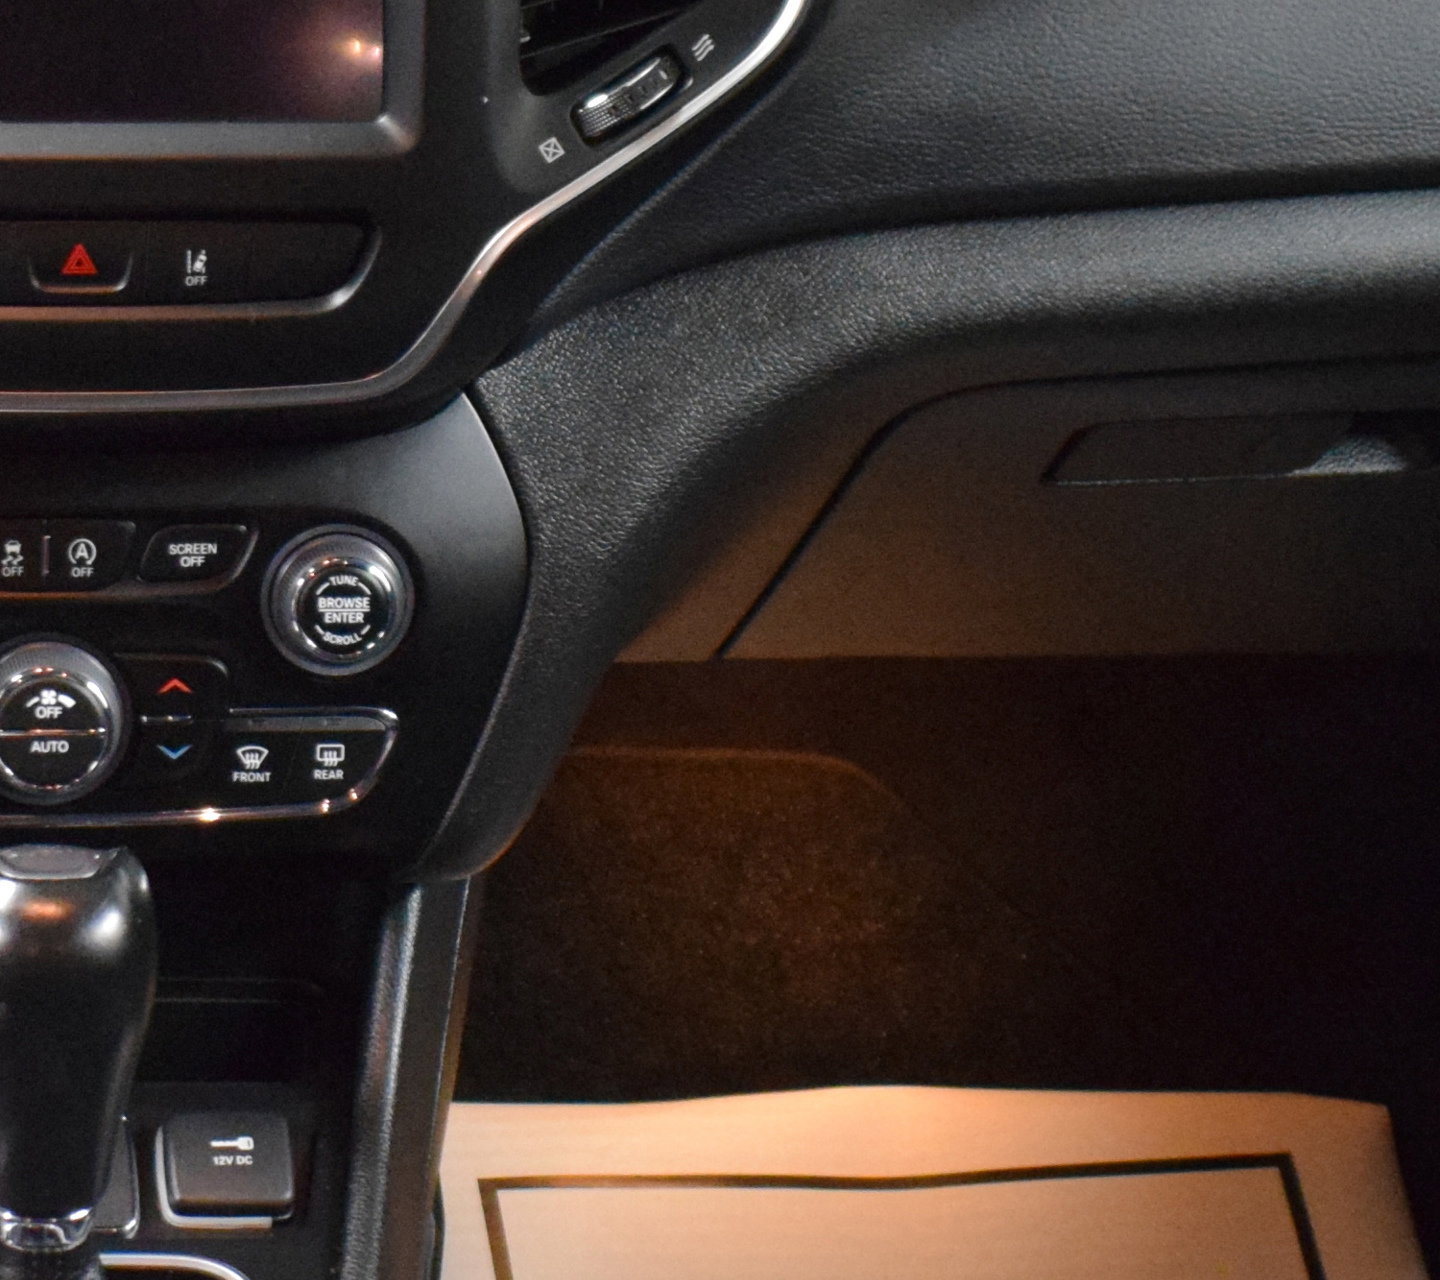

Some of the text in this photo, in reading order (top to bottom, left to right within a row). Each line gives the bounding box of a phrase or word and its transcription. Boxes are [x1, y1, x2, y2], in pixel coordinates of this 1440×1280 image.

[185, 275, 208, 287] OFF
[168, 543, 218, 556] SCREEN
[179, 555, 206, 568] OFF
[1, 566, 25, 578] OFF
[71, 566, 94, 578] OFF
[329, 575, 360, 588] TUNE
[318, 597, 371, 610] BROWSE
[323, 611, 365, 624] ENTER
[322, 631, 363, 646] SCROLL
[35, 706, 63, 720] OFF
[30, 740, 70, 754] AUTO
[232, 771, 271, 783] FRONT
[313, 769, 345, 781] REAR
[212, 1154, 253, 1166] 12V DC
